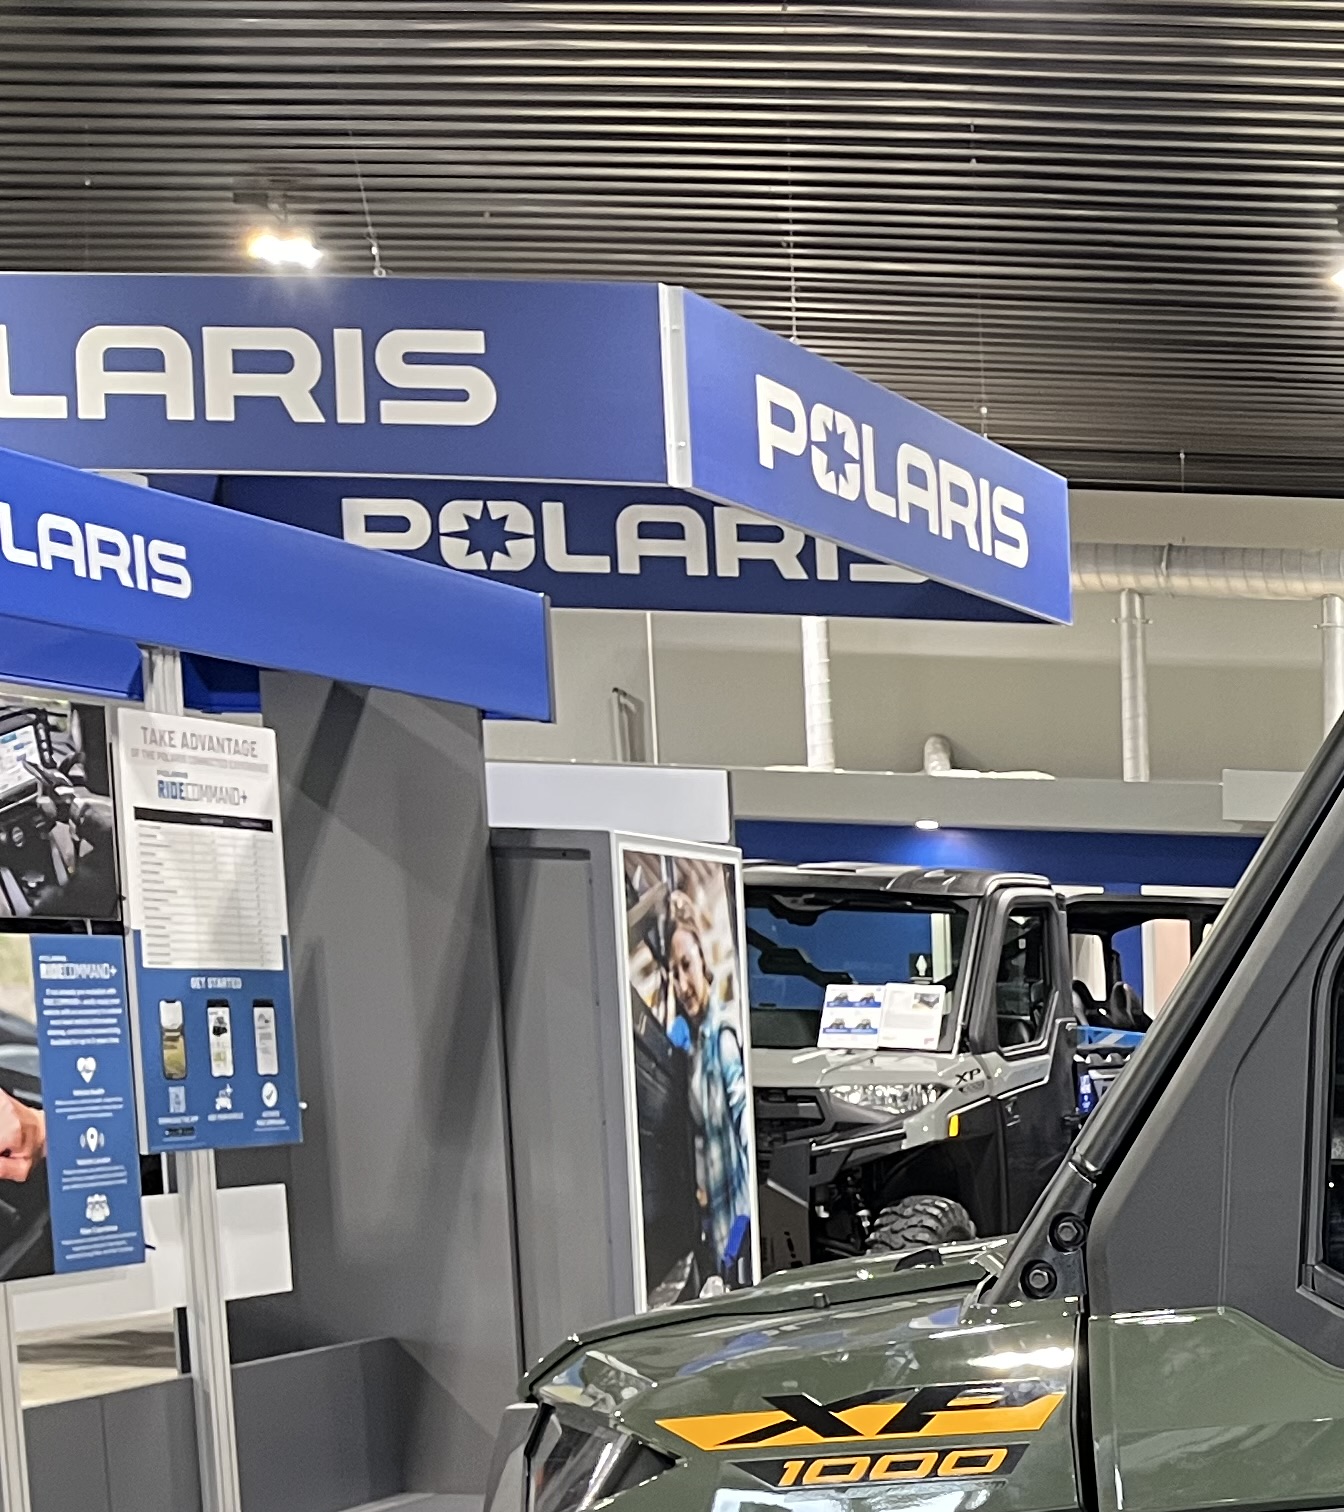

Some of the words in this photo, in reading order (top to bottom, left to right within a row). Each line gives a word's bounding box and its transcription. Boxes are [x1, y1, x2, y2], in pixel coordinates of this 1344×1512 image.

[755, 373, 1030, 570] POLARIS
[341, 497, 929, 585] POLARI
[140, 726, 177, 748] TAKE
[180, 731, 258, 758] ADVANTAGE
[954, 1067, 981, 1086] XP
[716, 1382, 1062, 1444] XP
[777, 1446, 1010, 1488] 1000
